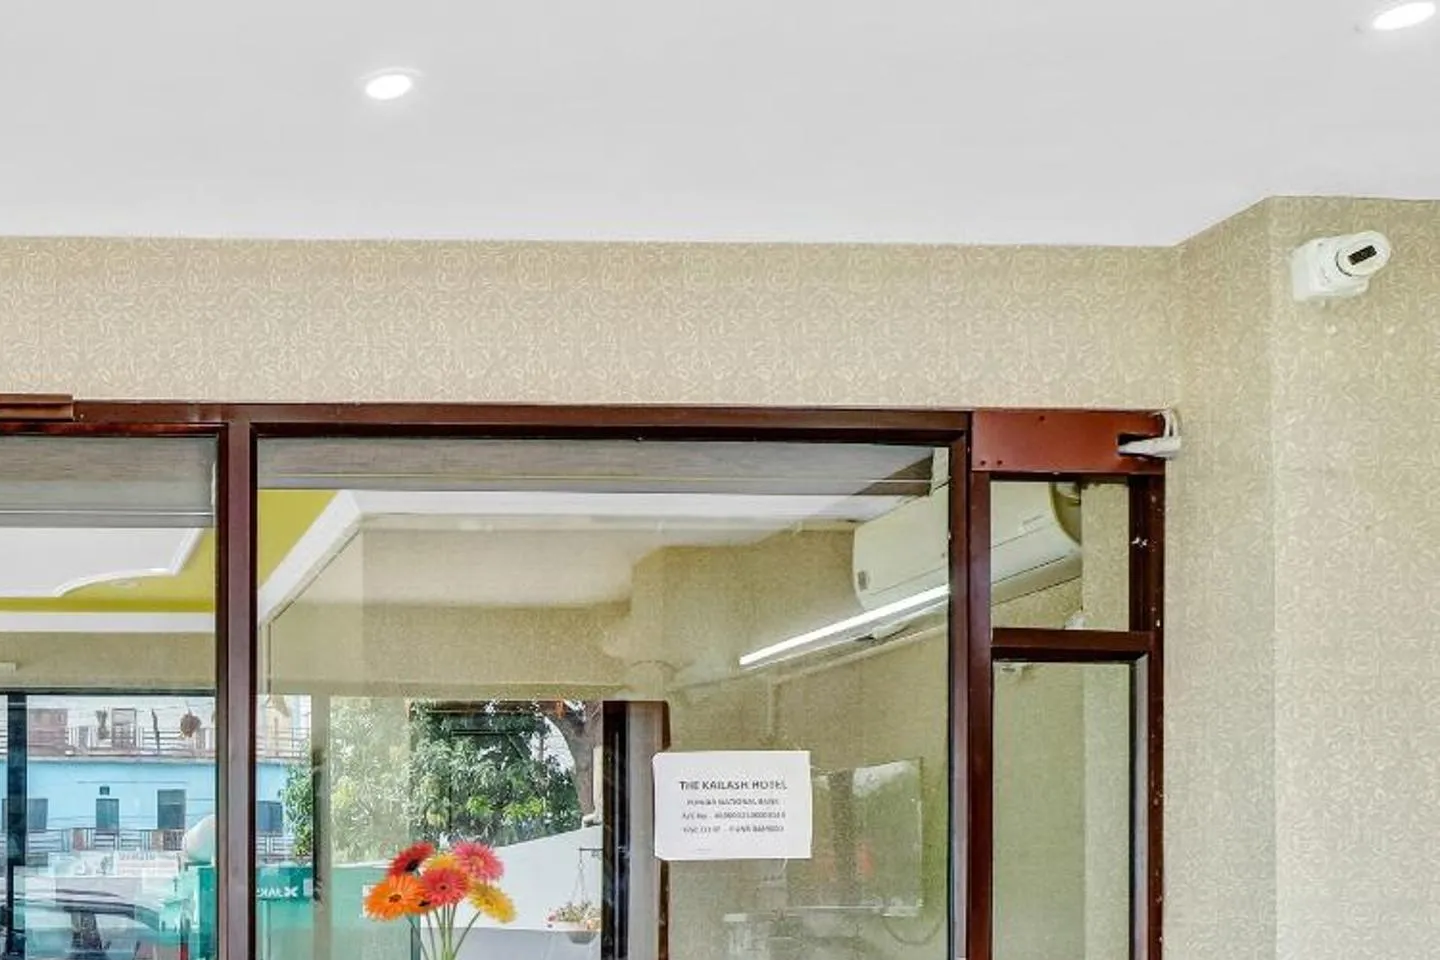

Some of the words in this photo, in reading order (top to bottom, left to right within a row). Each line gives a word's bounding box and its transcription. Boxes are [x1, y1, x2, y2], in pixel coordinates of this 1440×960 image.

[679, 781, 700, 790] THE
[702, 780, 748, 790] KAILASH
[752, 780, 788, 790] HOTEL
